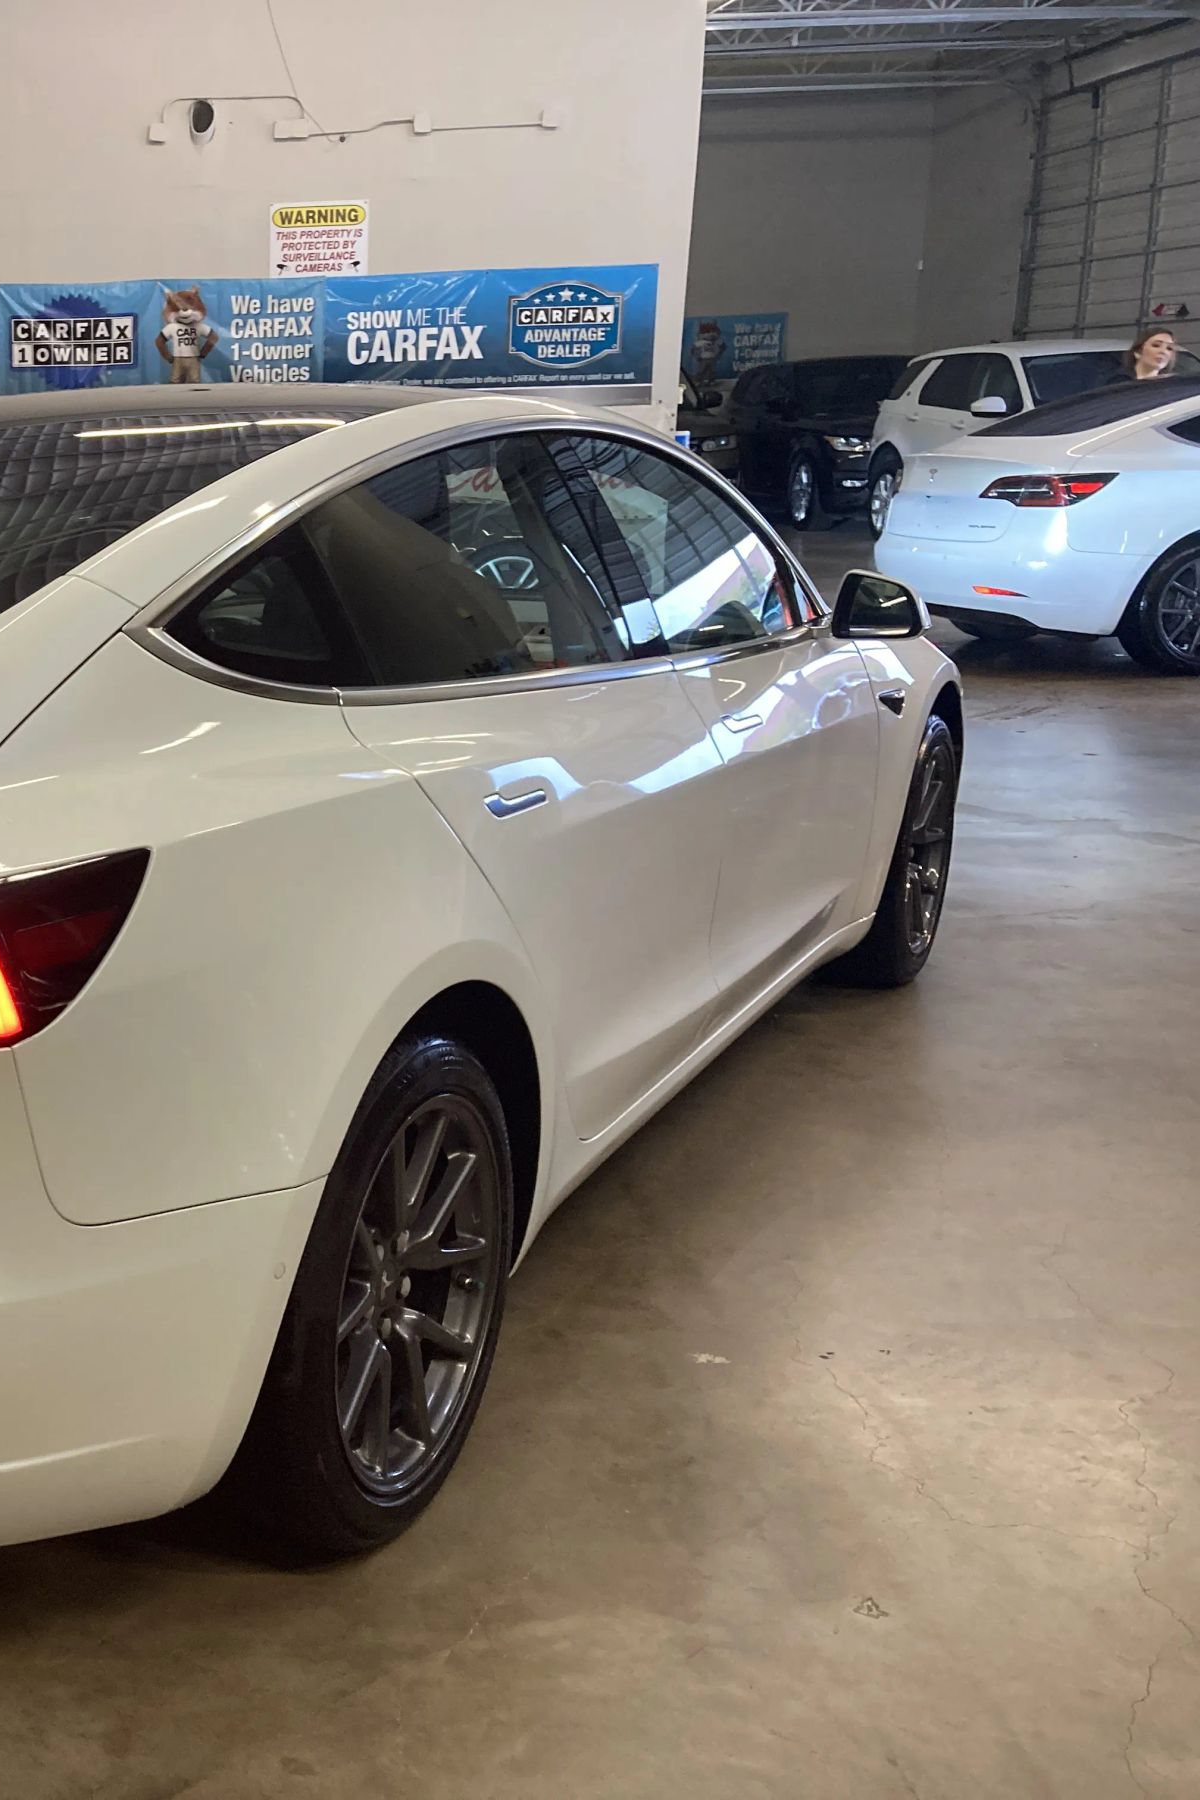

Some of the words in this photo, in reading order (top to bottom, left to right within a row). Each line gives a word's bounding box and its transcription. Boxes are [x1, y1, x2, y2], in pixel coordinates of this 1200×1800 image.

[279, 208, 359, 225] WARNING
[276, 231, 297, 240] THIS
[300, 229, 352, 240] PROPERTY
[353, 228, 363, 238] IS
[281, 240, 340, 252] PROTECTED
[342, 240, 357, 249] BY
[281, 251, 356, 263] SURVEILLANCE
[295, 262, 343, 273] CAMERAS
[231, 295, 261, 315] We
[267, 294, 314, 314] have
[346, 309, 402, 330] SHOW
[407, 308, 432, 327] ME
[435, 306, 467, 325] THE
[520, 309, 611, 323] CARFAX
[16, 321, 129, 339] CARFAX
[176, 328, 197, 337] CAR
[230, 316, 313, 339] CARFAX
[524, 327, 606, 343] ADVANTAGE
[178, 337, 198, 347] FOX
[347, 325, 484, 366] CARFAX
[231, 342, 314, 361] 1-Owner
[538, 343, 591, 359] DEALER
[229, 363, 310, 383] Vehicles
